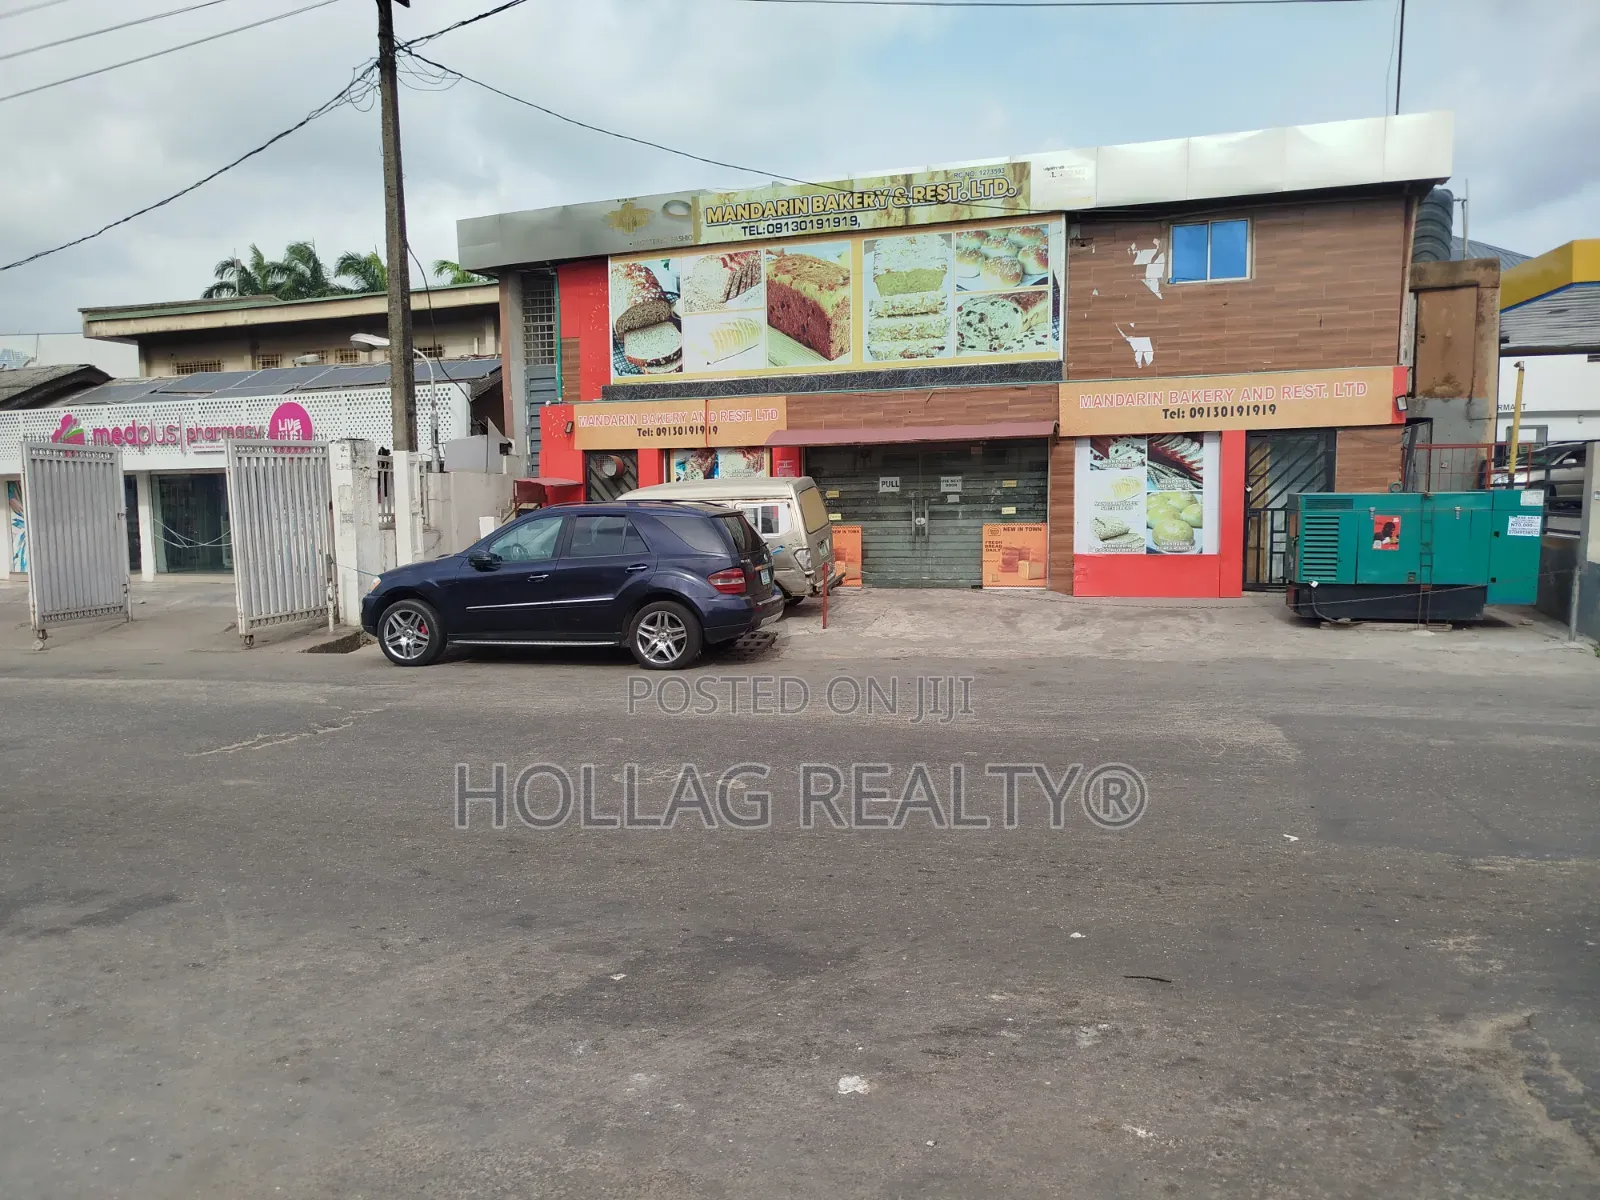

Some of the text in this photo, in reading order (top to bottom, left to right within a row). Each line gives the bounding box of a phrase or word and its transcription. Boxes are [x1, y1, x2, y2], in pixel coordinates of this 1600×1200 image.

[706, 177, 1018, 227] MANDARIN BAKERY & REST. LTD.
[671, 234, 693, 243] FASHIO
[1079, 381, 1368, 409] MANDARIN BAKERY AND REST. LTD
[578, 408, 779, 428] MANDARIN BAKERY AND REST. LTD
[1162, 403, 1277, 420] Tel: 09130191919
[92, 418, 262, 452] medplus pharmacy
[637, 425, 718, 438] Tel: 09130191919
[881, 480, 900, 488] PULL
